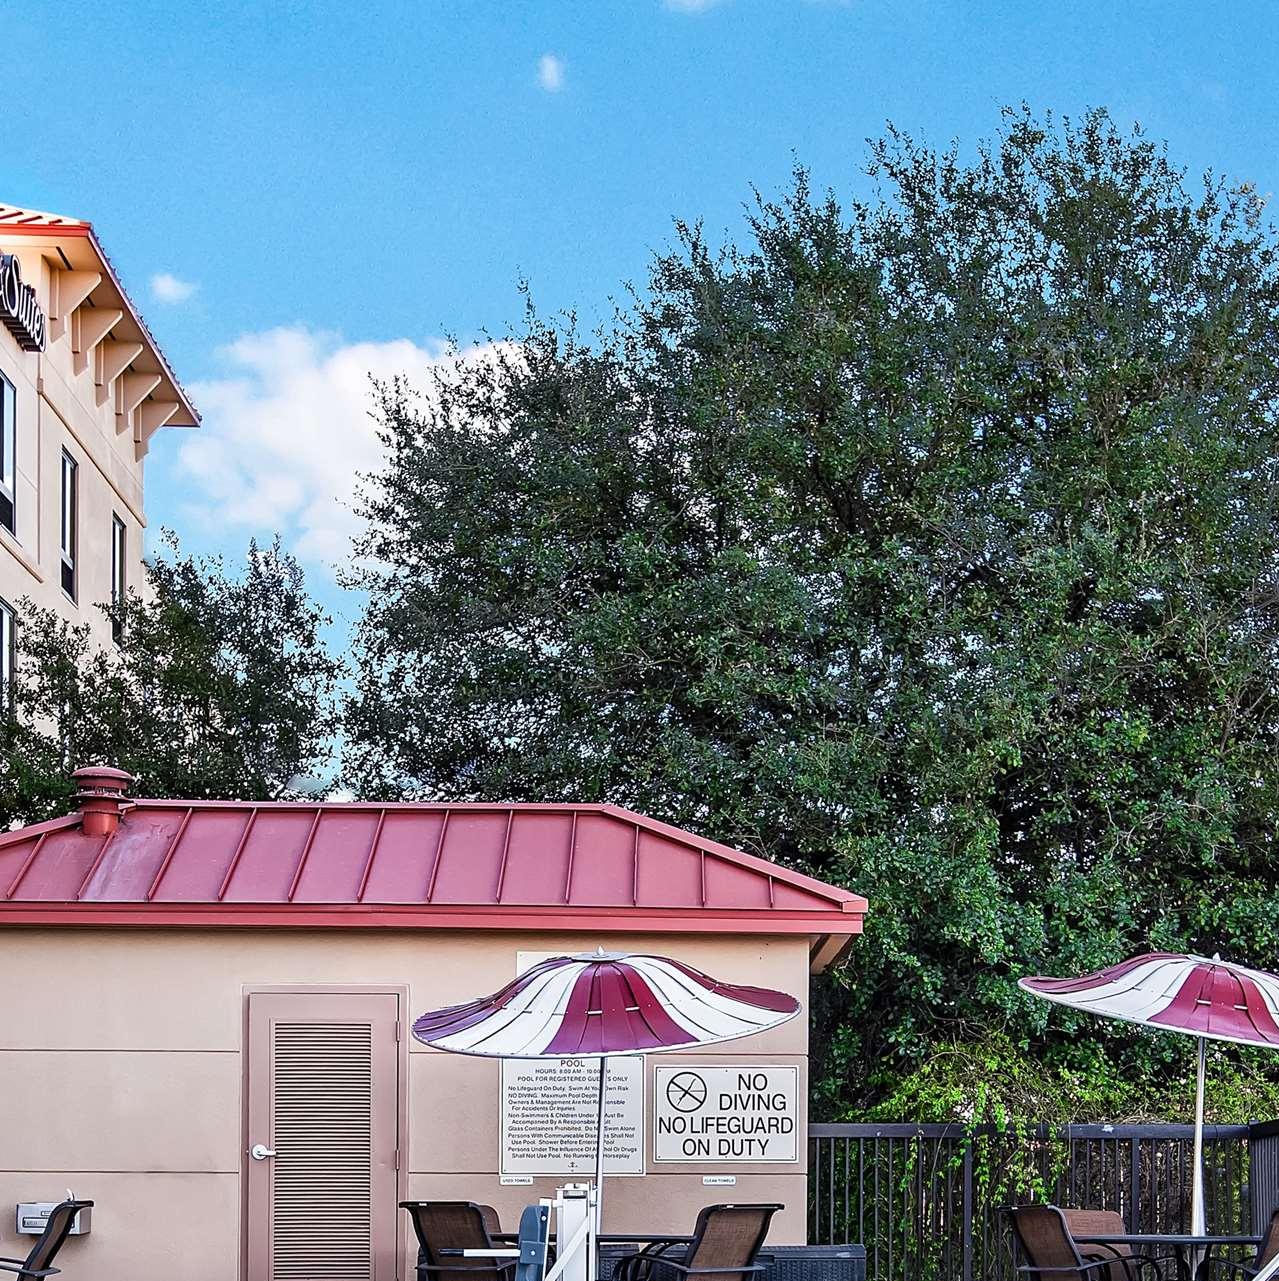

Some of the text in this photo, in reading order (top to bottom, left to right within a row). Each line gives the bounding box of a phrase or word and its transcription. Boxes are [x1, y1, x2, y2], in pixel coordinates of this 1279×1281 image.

[5, 254, 47, 351] Suites
[738, 1073, 768, 1091] NO
[719, 1093, 787, 1111] DIVING
[658, 1116, 793, 1134] NO LIFEGUARD
[682, 1138, 769, 1156] ON DUTY
